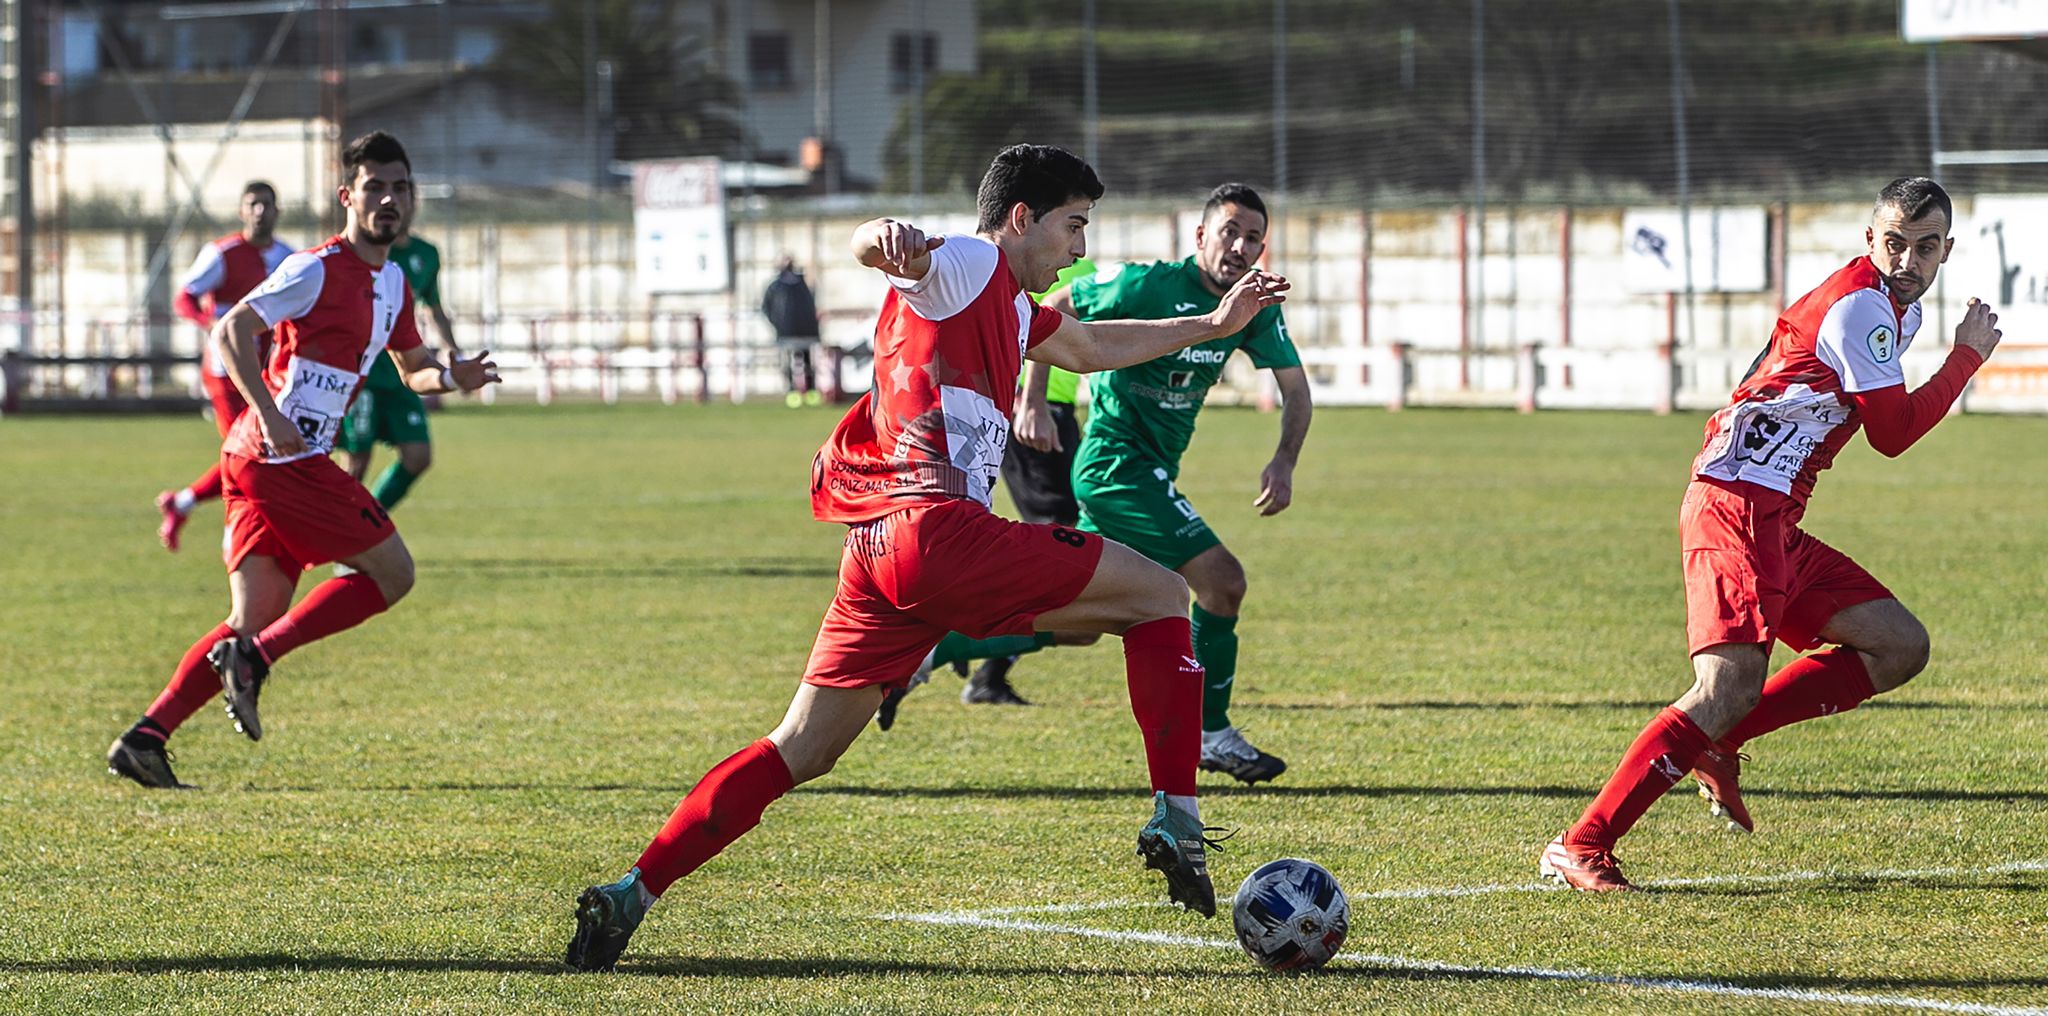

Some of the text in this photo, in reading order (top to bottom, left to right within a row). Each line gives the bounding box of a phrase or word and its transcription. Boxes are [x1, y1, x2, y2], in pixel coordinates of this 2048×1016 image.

[831, 459, 891, 476] COMERCIAL
[831, 477, 891, 492] CRUZ-MAR
[1052, 527, 1086, 549] 8
